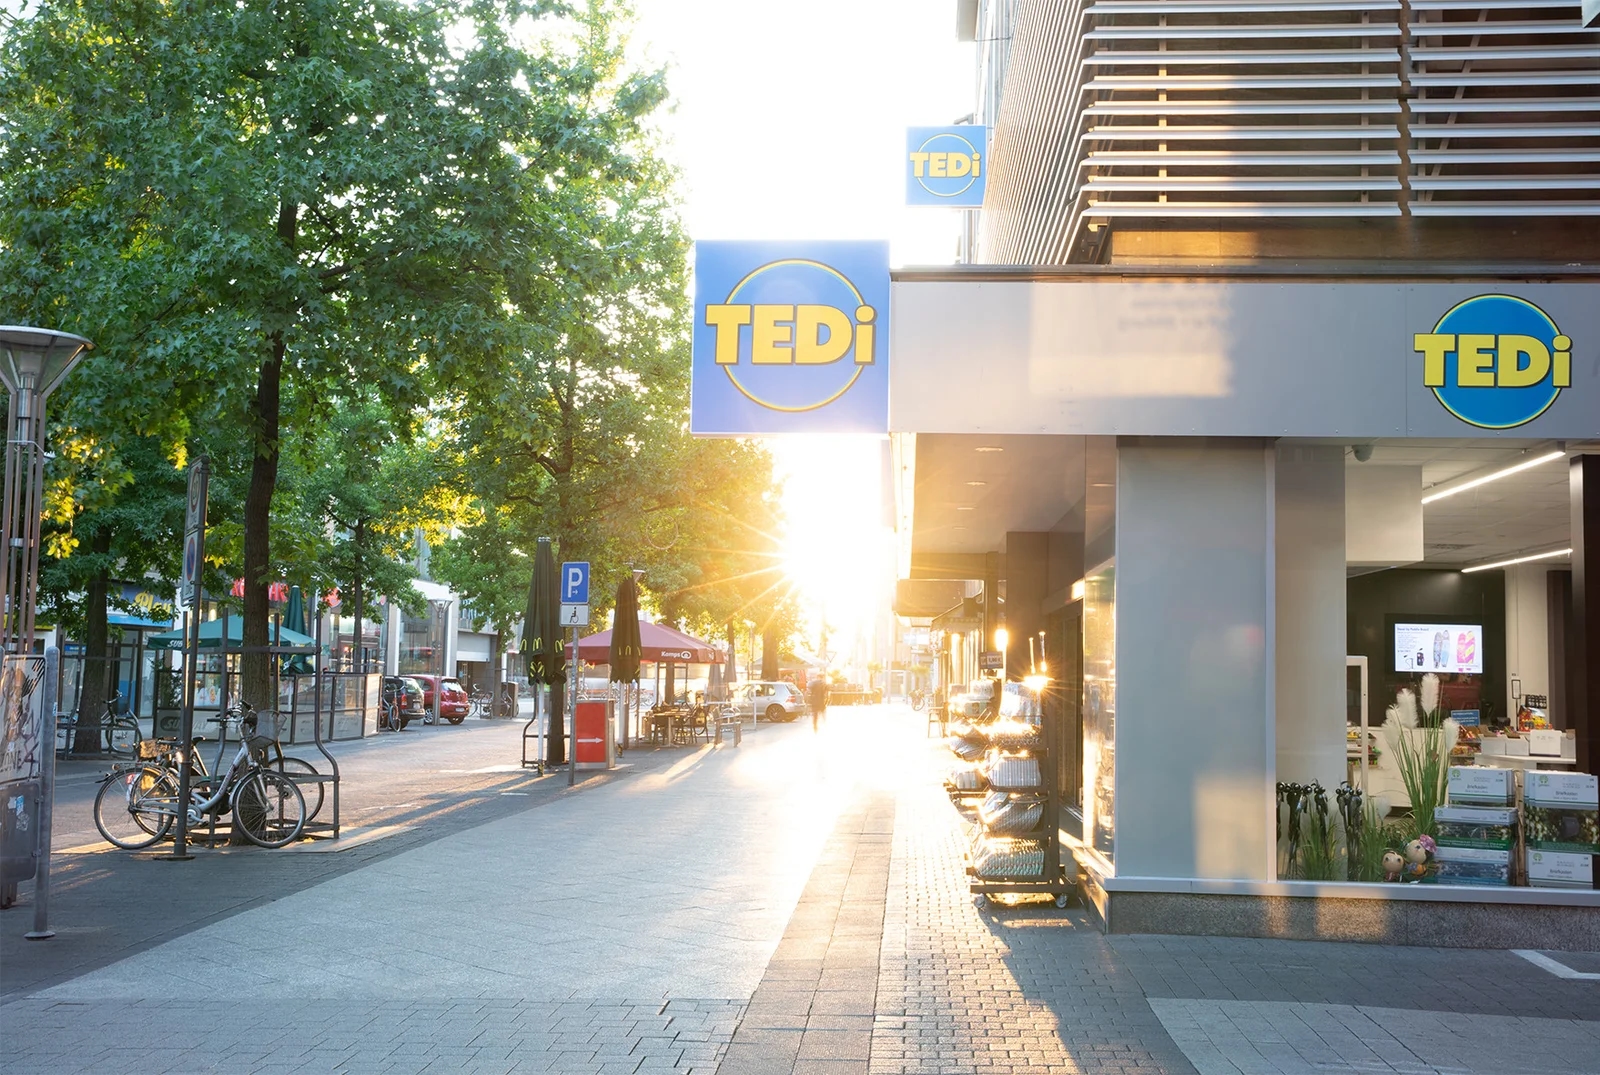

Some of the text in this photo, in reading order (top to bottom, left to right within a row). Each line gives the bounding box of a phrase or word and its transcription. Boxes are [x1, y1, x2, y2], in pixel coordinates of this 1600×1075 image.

[909, 151, 981, 178] TEDi
[704, 303, 876, 366] TEDi
[1413, 333, 1573, 388] TEDi
[567, 567, 583, 598] P
